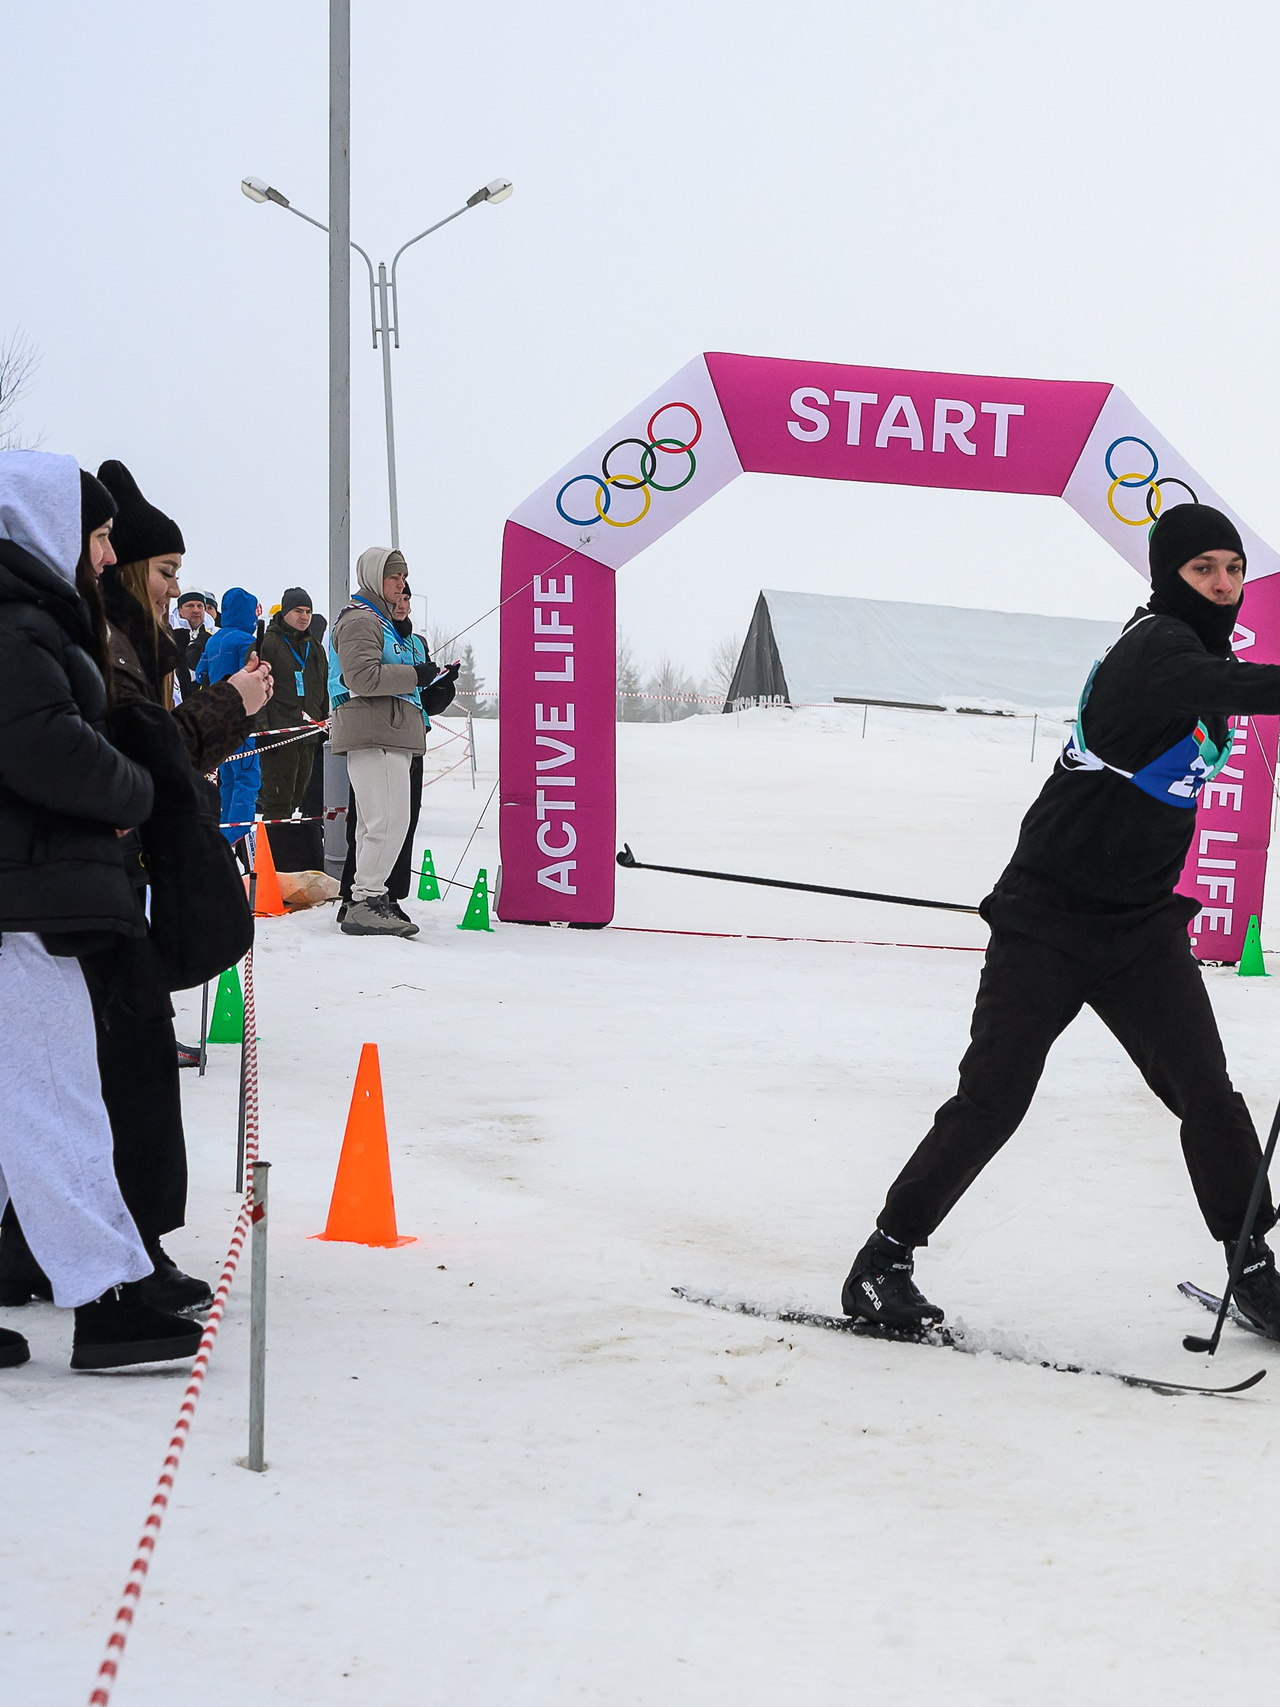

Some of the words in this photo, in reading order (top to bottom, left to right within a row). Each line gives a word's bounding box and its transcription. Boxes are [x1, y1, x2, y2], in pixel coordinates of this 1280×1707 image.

[786, 386, 1025, 458] START
[532, 572, 575, 682] LIFE
[1202, 622, 1257, 812] AIVE
[534, 700, 577, 896] ACTIVE
[1192, 828, 1239, 936] LIFE
[861, 1281, 883, 1311] alpina
[1243, 1260, 1267, 1275] alpina
